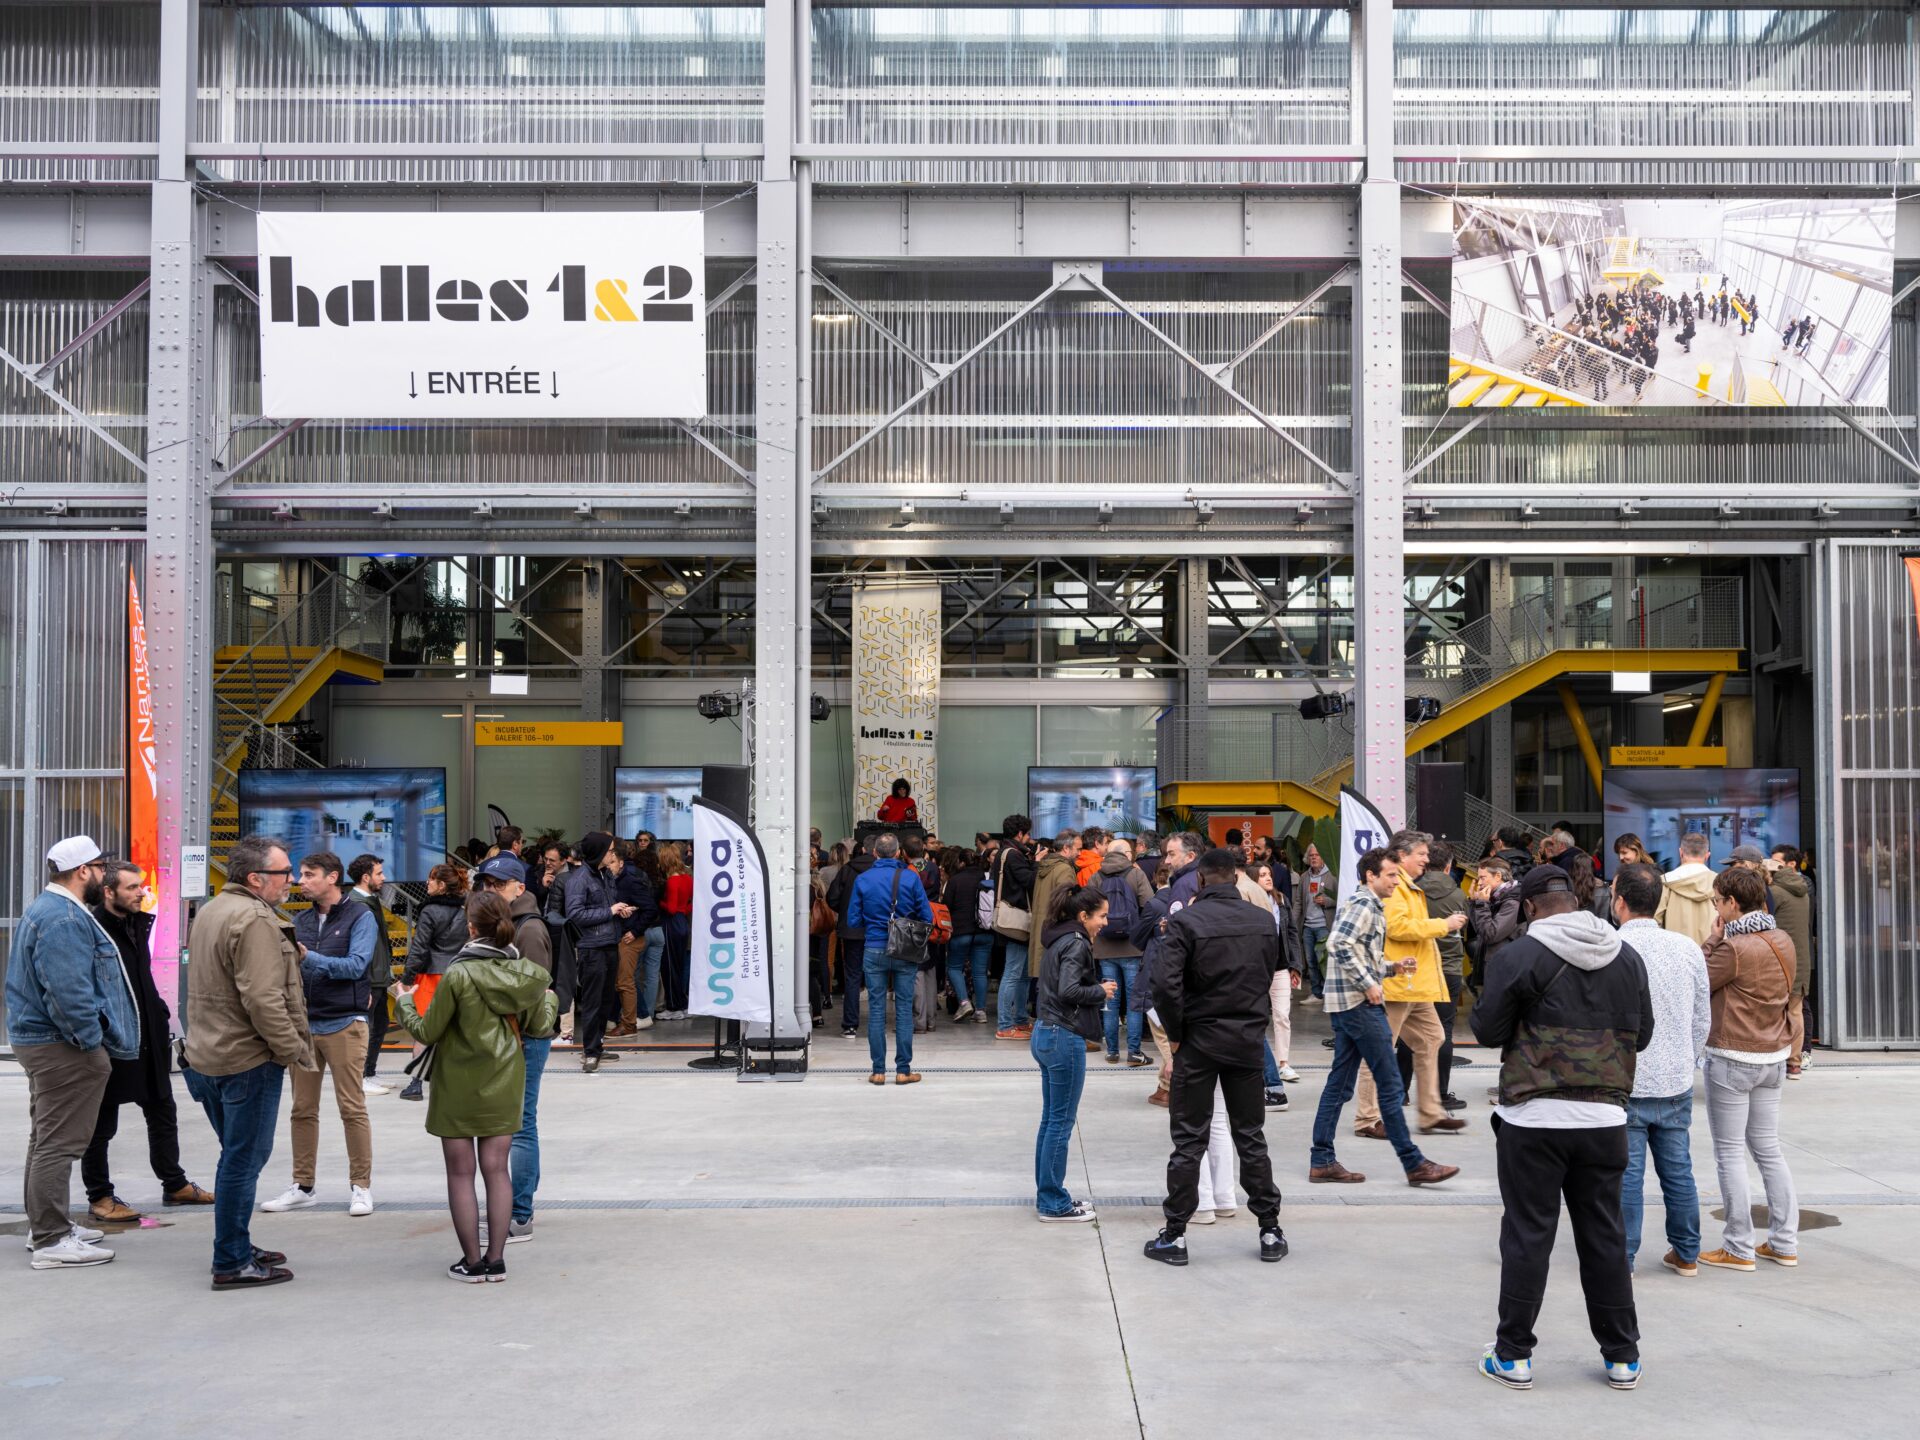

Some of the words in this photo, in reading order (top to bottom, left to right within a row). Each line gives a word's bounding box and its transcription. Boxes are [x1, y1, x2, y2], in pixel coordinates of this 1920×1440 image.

[269, 255, 530, 327] halles
[546, 264, 694, 322] 1&2
[427, 365, 541, 395] ENTRÉE
[495, 734, 523, 742] GALERIE
[860, 725, 905, 739] halles
[736, 838, 745, 880] créative
[738, 882, 746, 890] &
[707, 839, 736, 1006] samoa
[739, 892, 748, 932] urbaine
[750, 891, 758, 927] Nantes
[751, 929, 758, 942] de
[741, 935, 750, 979] Fabrique
[753, 965, 760, 977] de
